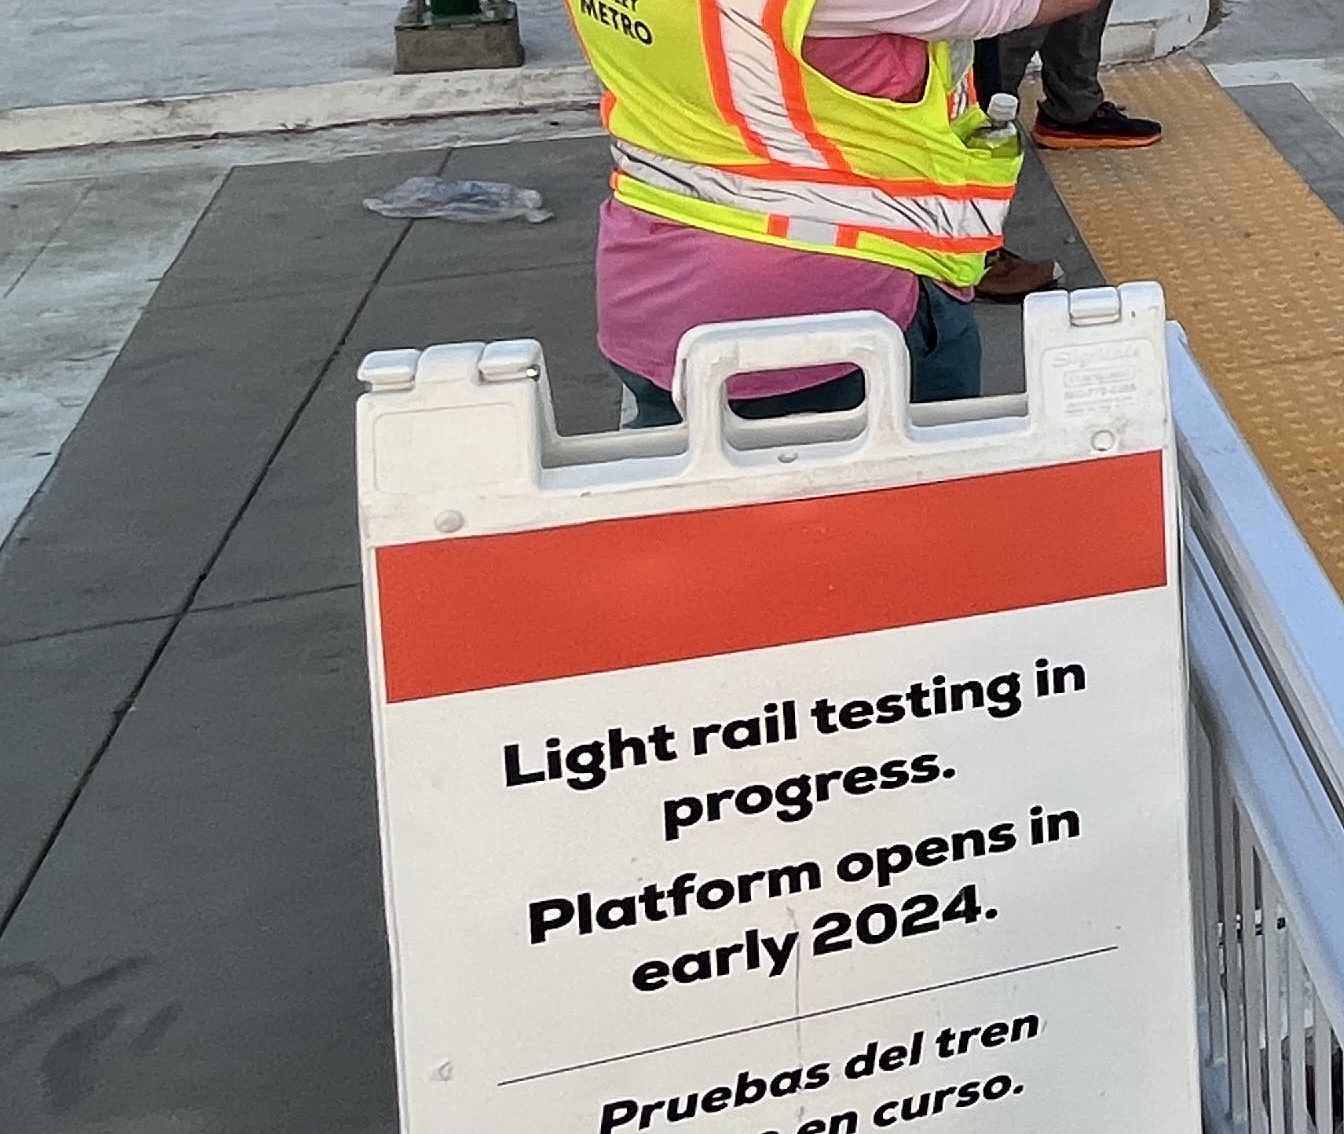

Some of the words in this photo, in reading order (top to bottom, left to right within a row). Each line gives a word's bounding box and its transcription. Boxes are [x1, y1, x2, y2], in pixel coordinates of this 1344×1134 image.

[504, 724, 678, 791] Light
[692, 700, 797, 756] rail
[810, 671, 1022, 734] testing
[1035, 658, 1086, 697] in
[664, 754, 957, 842] progress.
[529, 861, 822, 945] Platform
[836, 823, 1017, 888] opens
[1030, 805, 1080, 846] in
[632, 928, 800, 992] early
[812, 884, 999, 956] 2024.
[600, 1062, 830, 1134] Pruebas
[844, 1030, 924, 1080] del
[935, 1014, 1039, 1058] tren
[873, 1075, 1025, 1127] curso.
